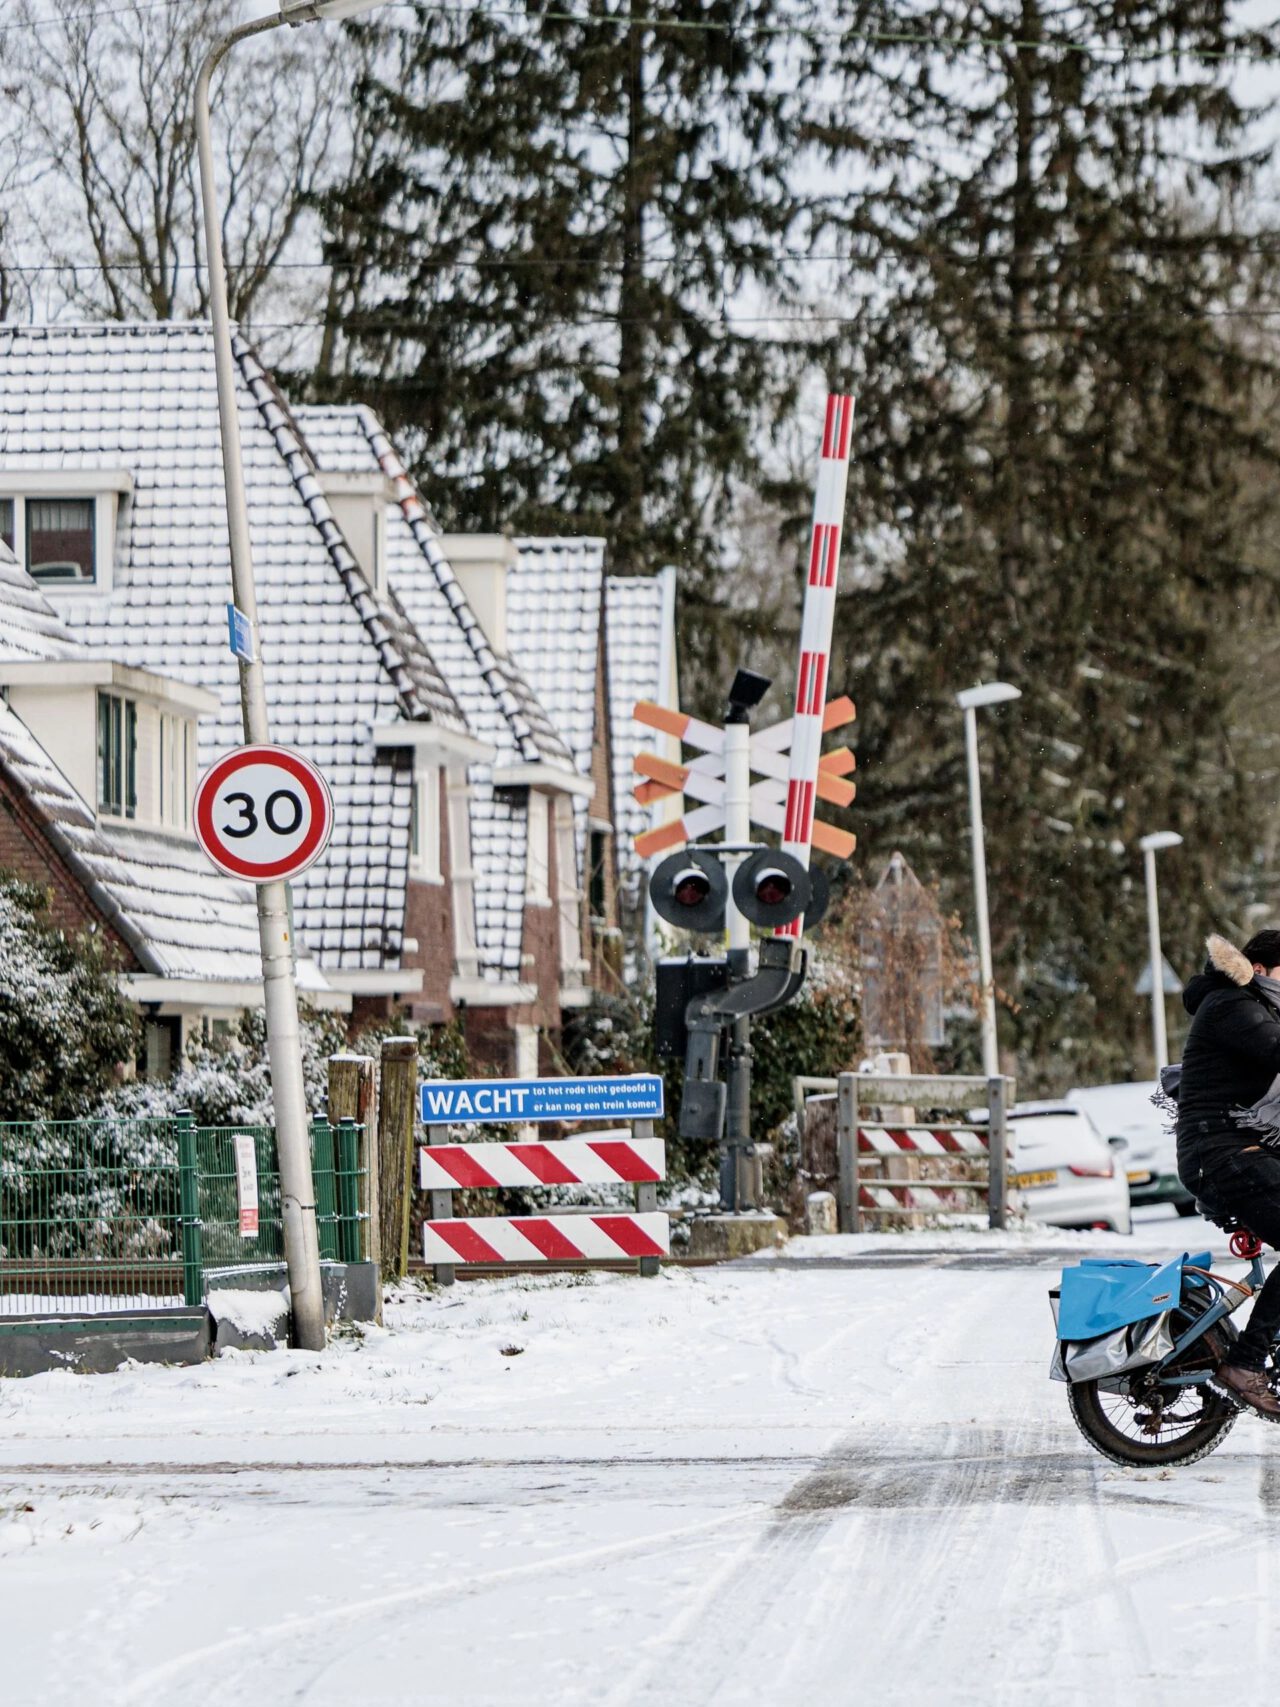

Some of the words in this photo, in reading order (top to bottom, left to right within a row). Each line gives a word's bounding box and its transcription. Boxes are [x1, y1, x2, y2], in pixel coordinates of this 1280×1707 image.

[222, 789, 303, 838] 30
[533, 1087, 546, 1096] tot
[548, 1086, 563, 1095] het
[565, 1085, 586, 1095] rode
[587, 1085, 608, 1094] licht
[609, 1084, 647, 1096] gedoofd
[648, 1083, 656, 1093] is
[427, 1088, 530, 1115] WACHT
[534, 1104, 543, 1112] er
[546, 1102, 562, 1111] kan
[564, 1103, 582, 1113] nog
[584, 1102, 600, 1110] een
[602, 1100, 625, 1110] trein
[627, 1100, 657, 1109] komen
